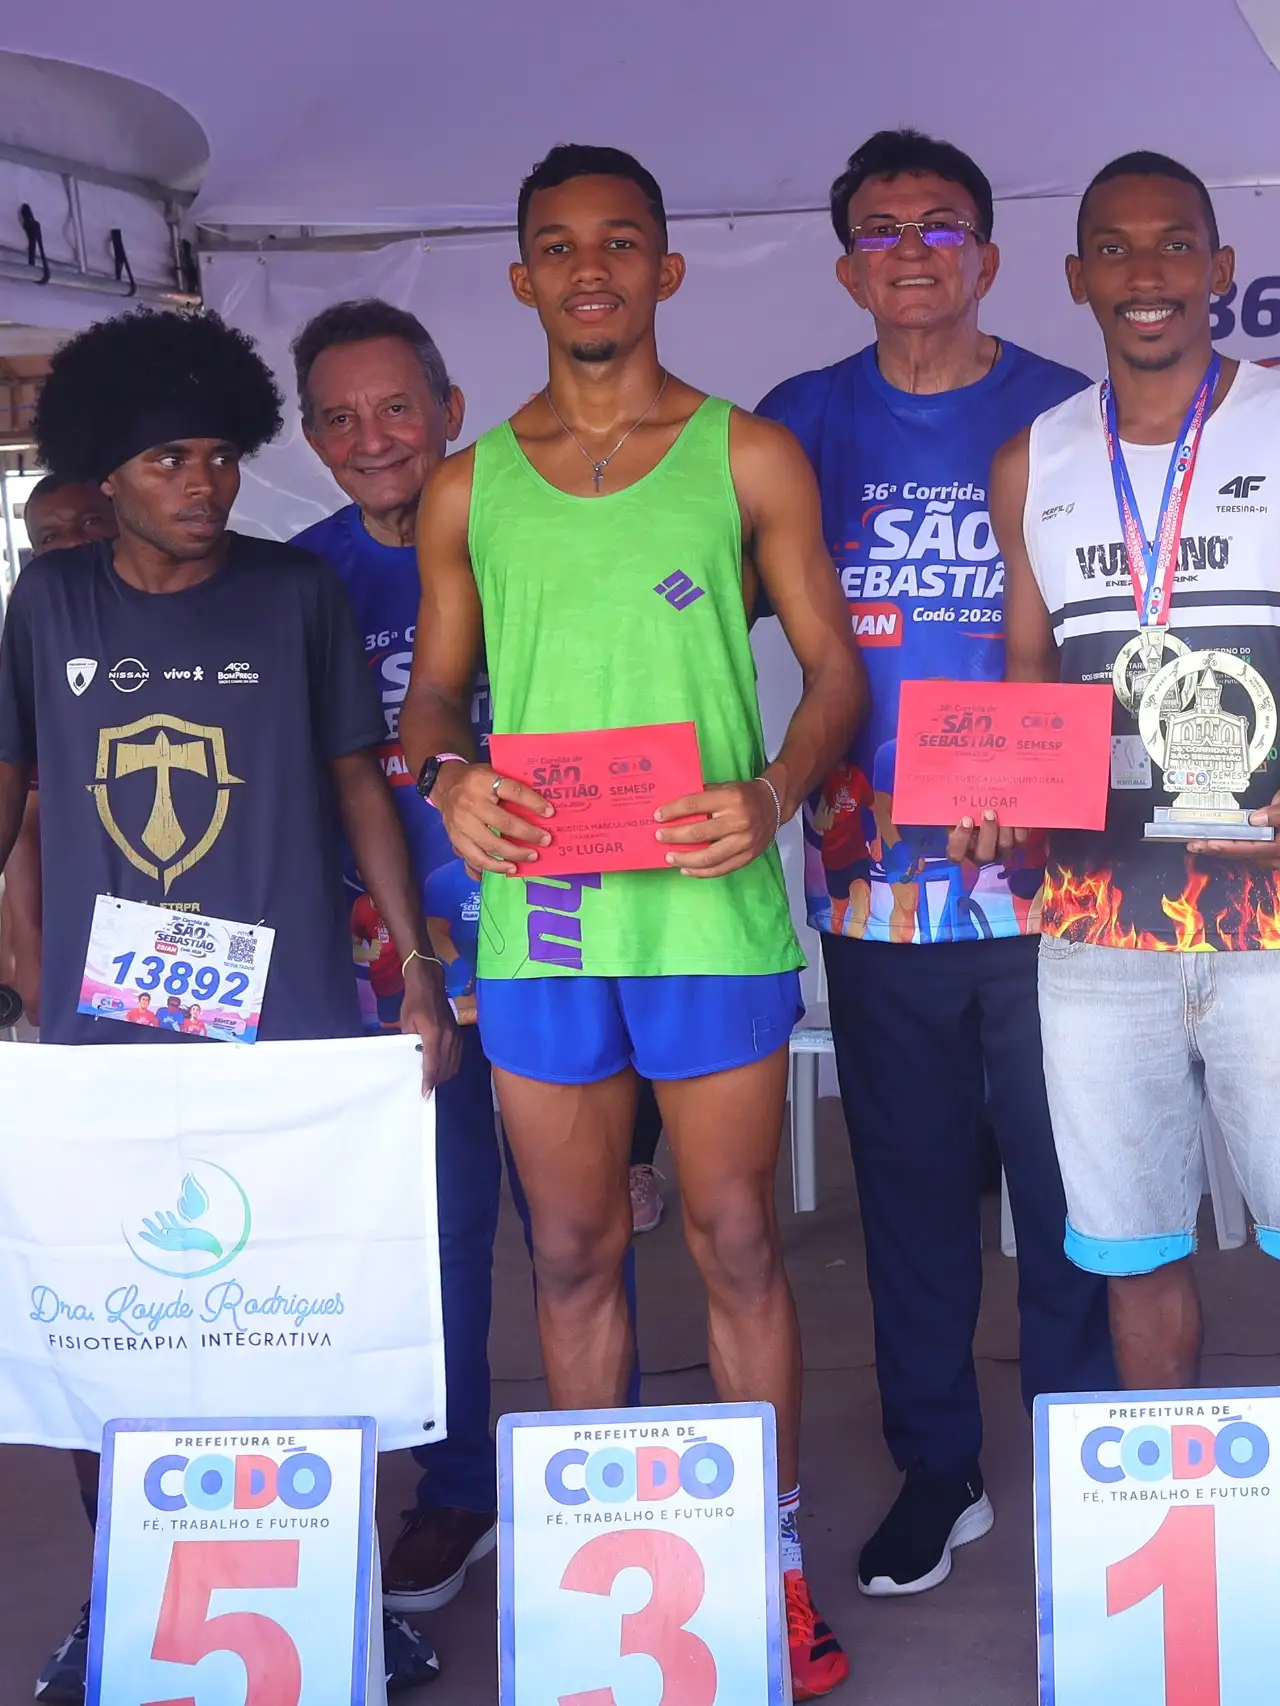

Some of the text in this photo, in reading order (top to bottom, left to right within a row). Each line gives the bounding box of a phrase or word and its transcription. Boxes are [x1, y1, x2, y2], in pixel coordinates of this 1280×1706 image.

[862, 482, 986, 501] 36ª Corrida
[1216, 505, 1268, 513] TERESINA-PI
[868, 500, 1000, 561] SÃO
[838, 562, 1005, 599] EBASTIÃ
[912, 606, 1002, 623] Codó 2026
[851, 613, 897, 635] JAN
[108, 671, 150, 679] NISSAN
[164, 668, 191, 680] vivo
[942, 712, 992, 734] SÃO
[918, 733, 1007, 748] SEBASTIÃO
[1016, 740, 1063, 750] SEMESP
[1185, 747, 1227, 755] CORRIDA
[532, 764, 581, 788] SÃO
[1212, 771, 1249, 780] SEMESP
[609, 783, 655, 796] SEMESP
[970, 796, 1018, 808] LUGAR
[576, 841, 624, 856] LUGAR
[172, 922, 206, 939] SÃO
[156, 932, 214, 951] SEBASTIÃO
[112, 951, 250, 1007] 13892
[30, 1279, 345, 1336] Dra. Loyde Rodrigues
[48, 1332, 332, 1351] FISIOTERAPIA INTEGRATIVA
[1109, 1405, 1230, 1419] PREFEITURA DE
[175, 1436, 296, 1447] PREFEITURA DE
[574, 1426, 696, 1441] PREFEITURA DE
[1080, 1415, 1270, 1484] CODÓ
[143, 1446, 332, 1511] CODÓ
[544, 1435, 735, 1506] CODÓ
[1083, 1486, 1271, 1503] FÉ, TRABALHO E FUTURO
[143, 1517, 330, 1531] FÉ, TRABALHO E FUTURO
[546, 1507, 735, 1526] FÉ, TRABALHO E FUTURO
[1106, 1504, 1222, 1706] 1
[140, 1539, 302, 1706] 5
[557, 1528, 718, 1706] 3
